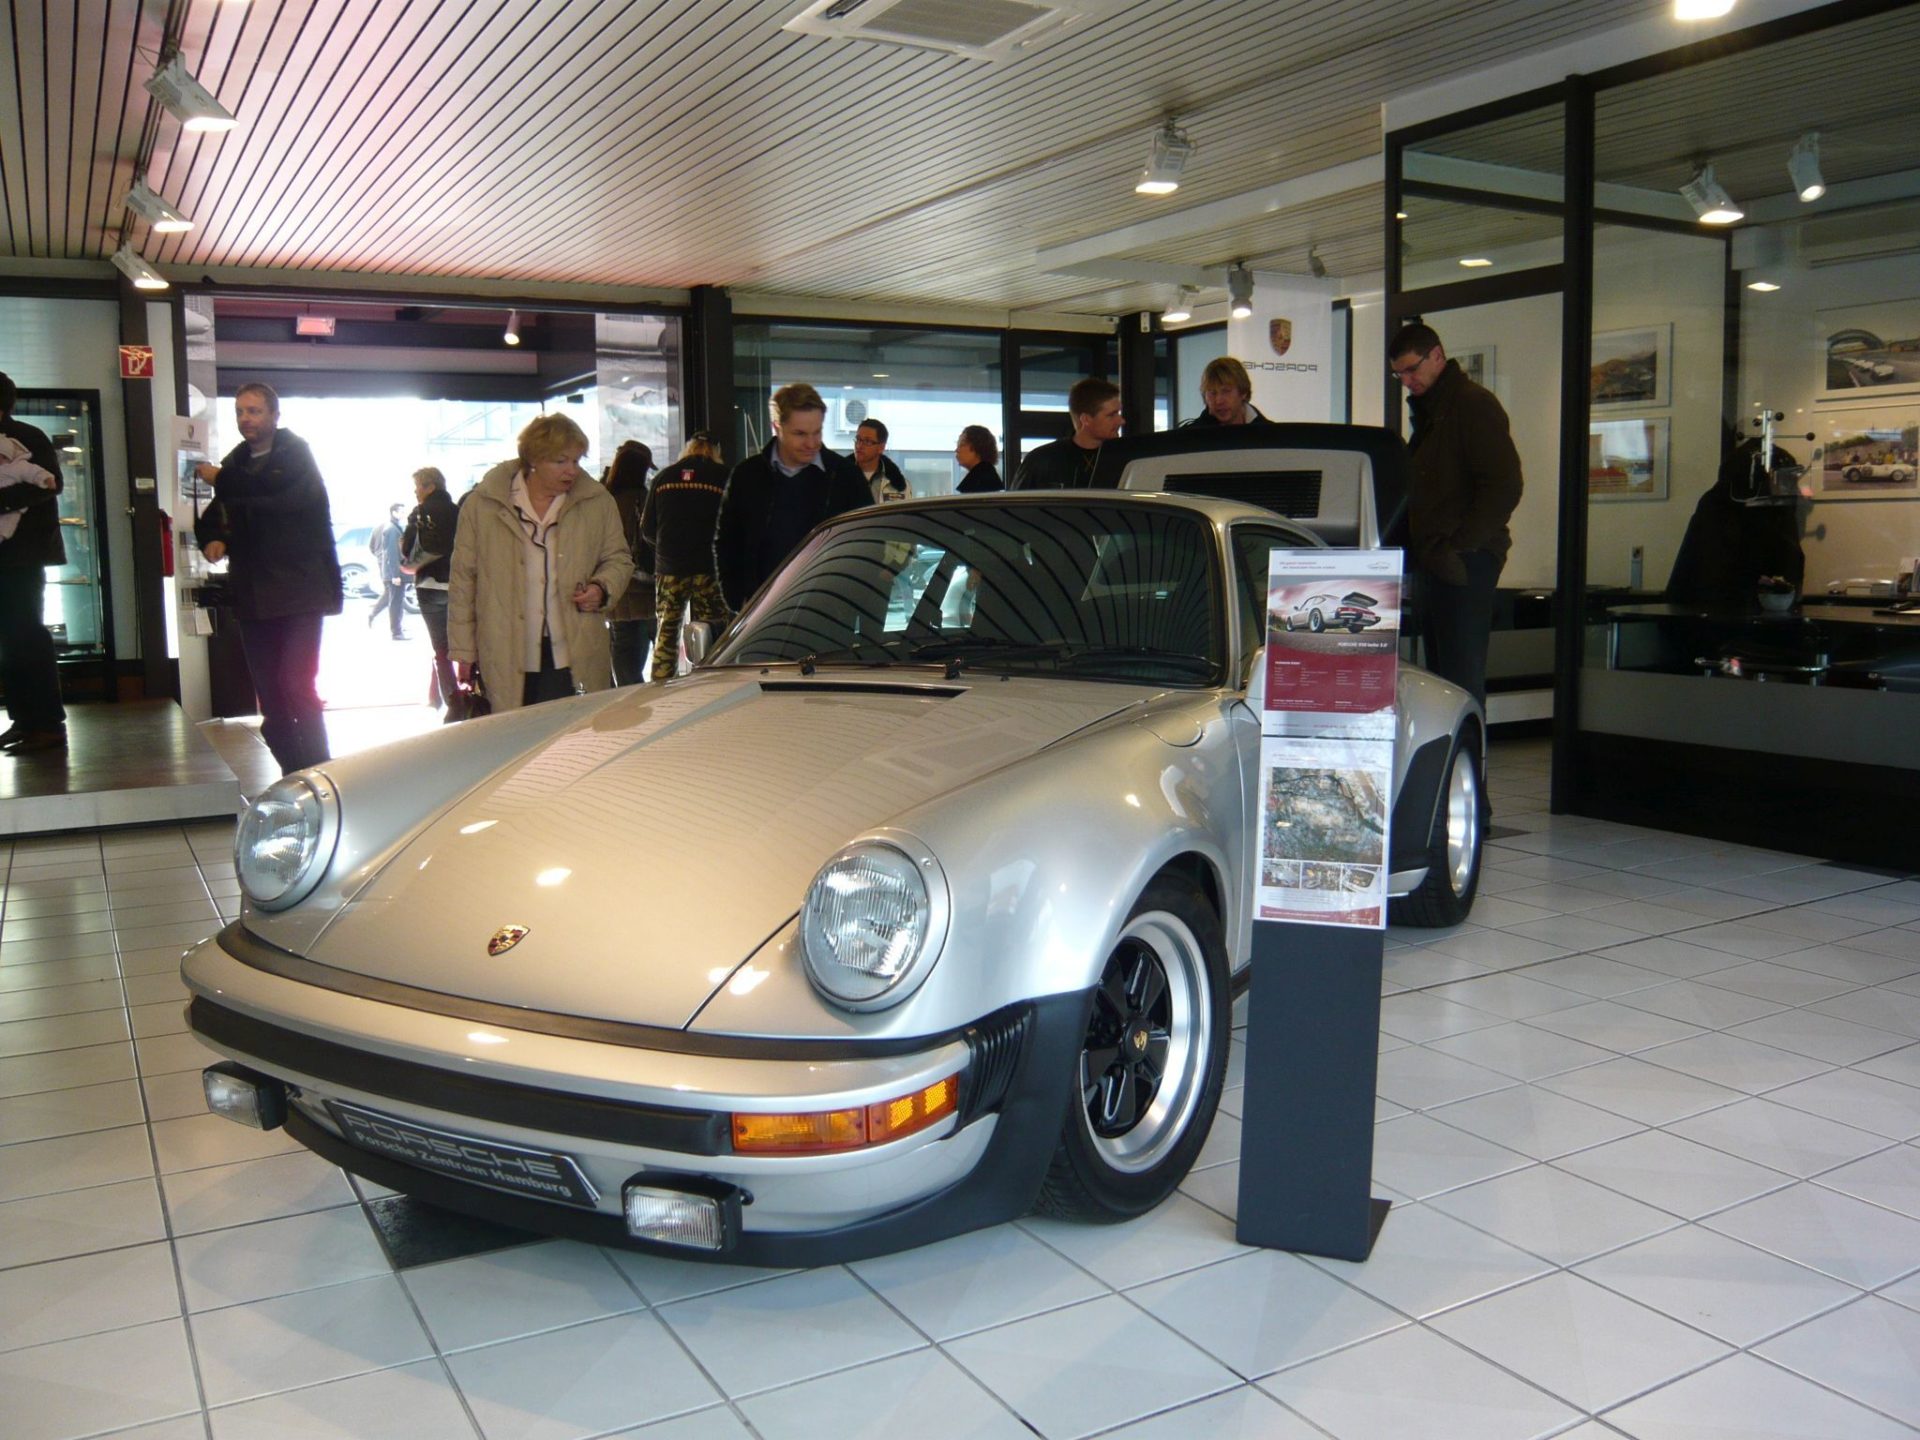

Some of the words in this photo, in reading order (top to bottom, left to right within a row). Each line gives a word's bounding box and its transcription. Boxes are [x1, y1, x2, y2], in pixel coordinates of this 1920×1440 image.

[342, 1113, 562, 1180] PORSCHE
[355, 1131, 417, 1158] Porsche
[418, 1150, 489, 1177] Zentrum
[490, 1168, 573, 1198] Hamburg
